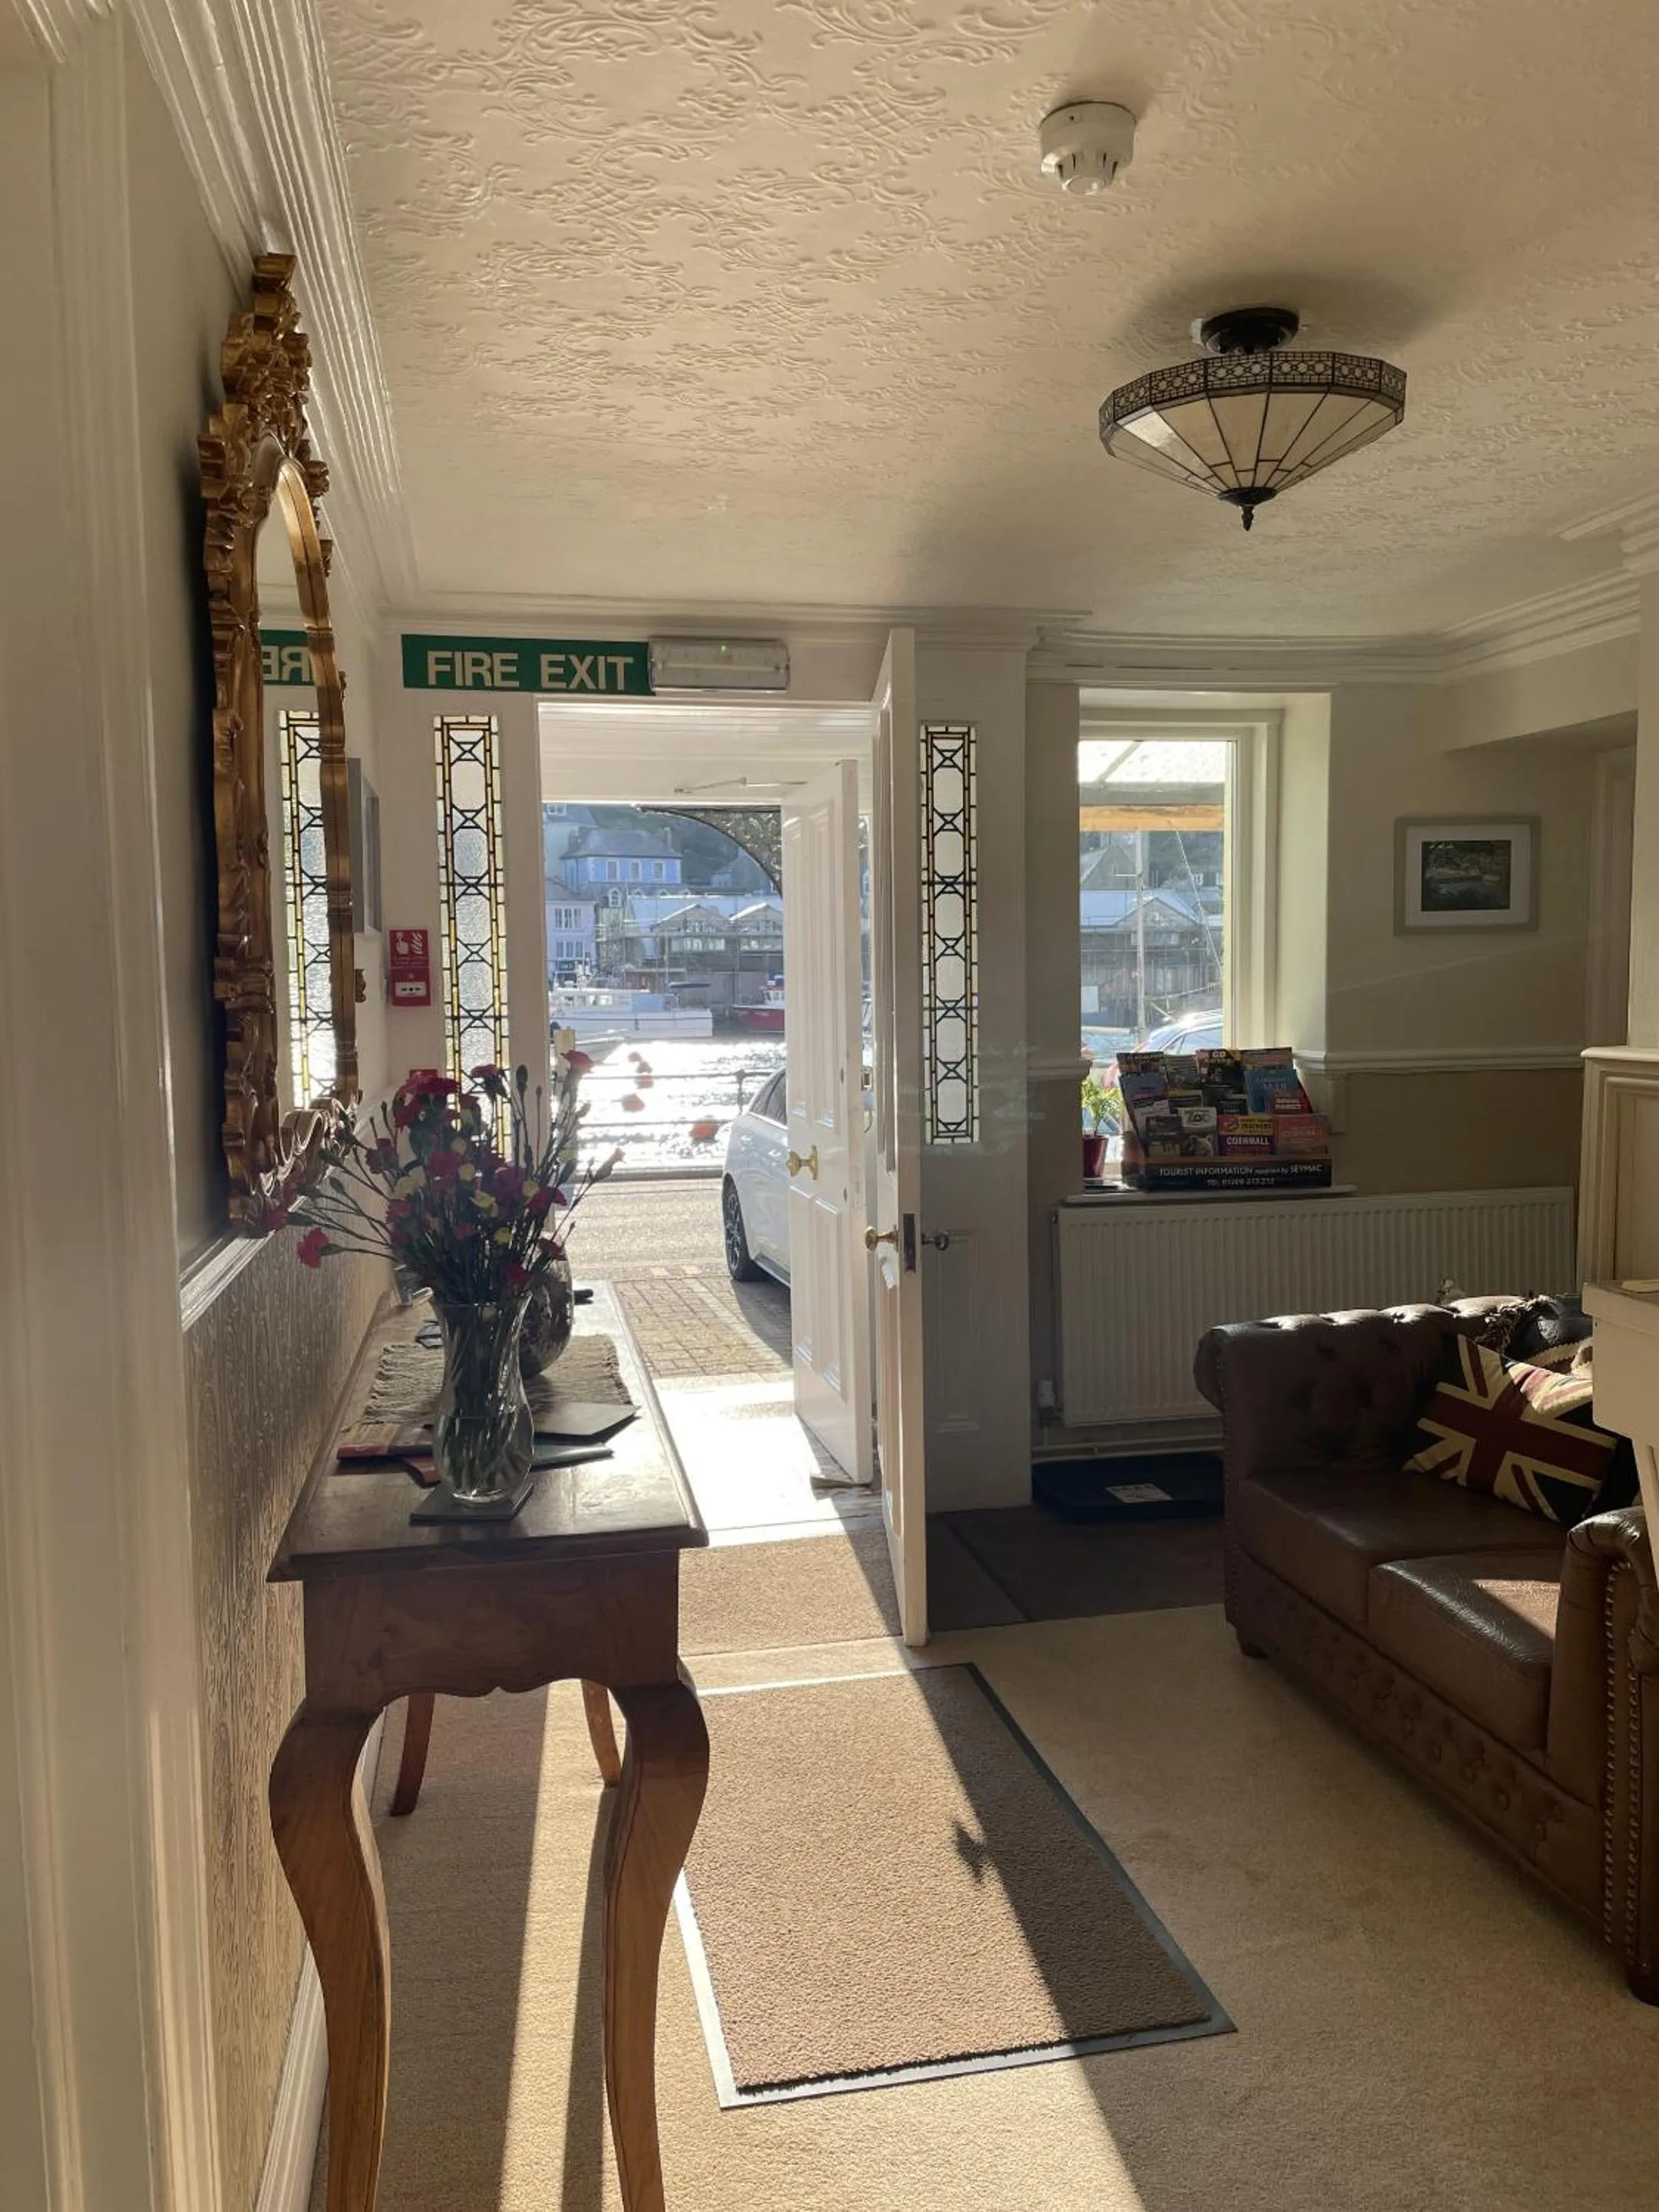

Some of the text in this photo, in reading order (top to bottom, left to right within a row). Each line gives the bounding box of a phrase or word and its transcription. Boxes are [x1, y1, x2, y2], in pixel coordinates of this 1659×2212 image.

[427, 650, 634, 690] FIRE EXIT
[1226, 1136, 1270, 1146] CORNWALL
[1159, 1167, 1194, 1176] TOURIST
[1195, 1166, 1253, 1175] INFORMATION
